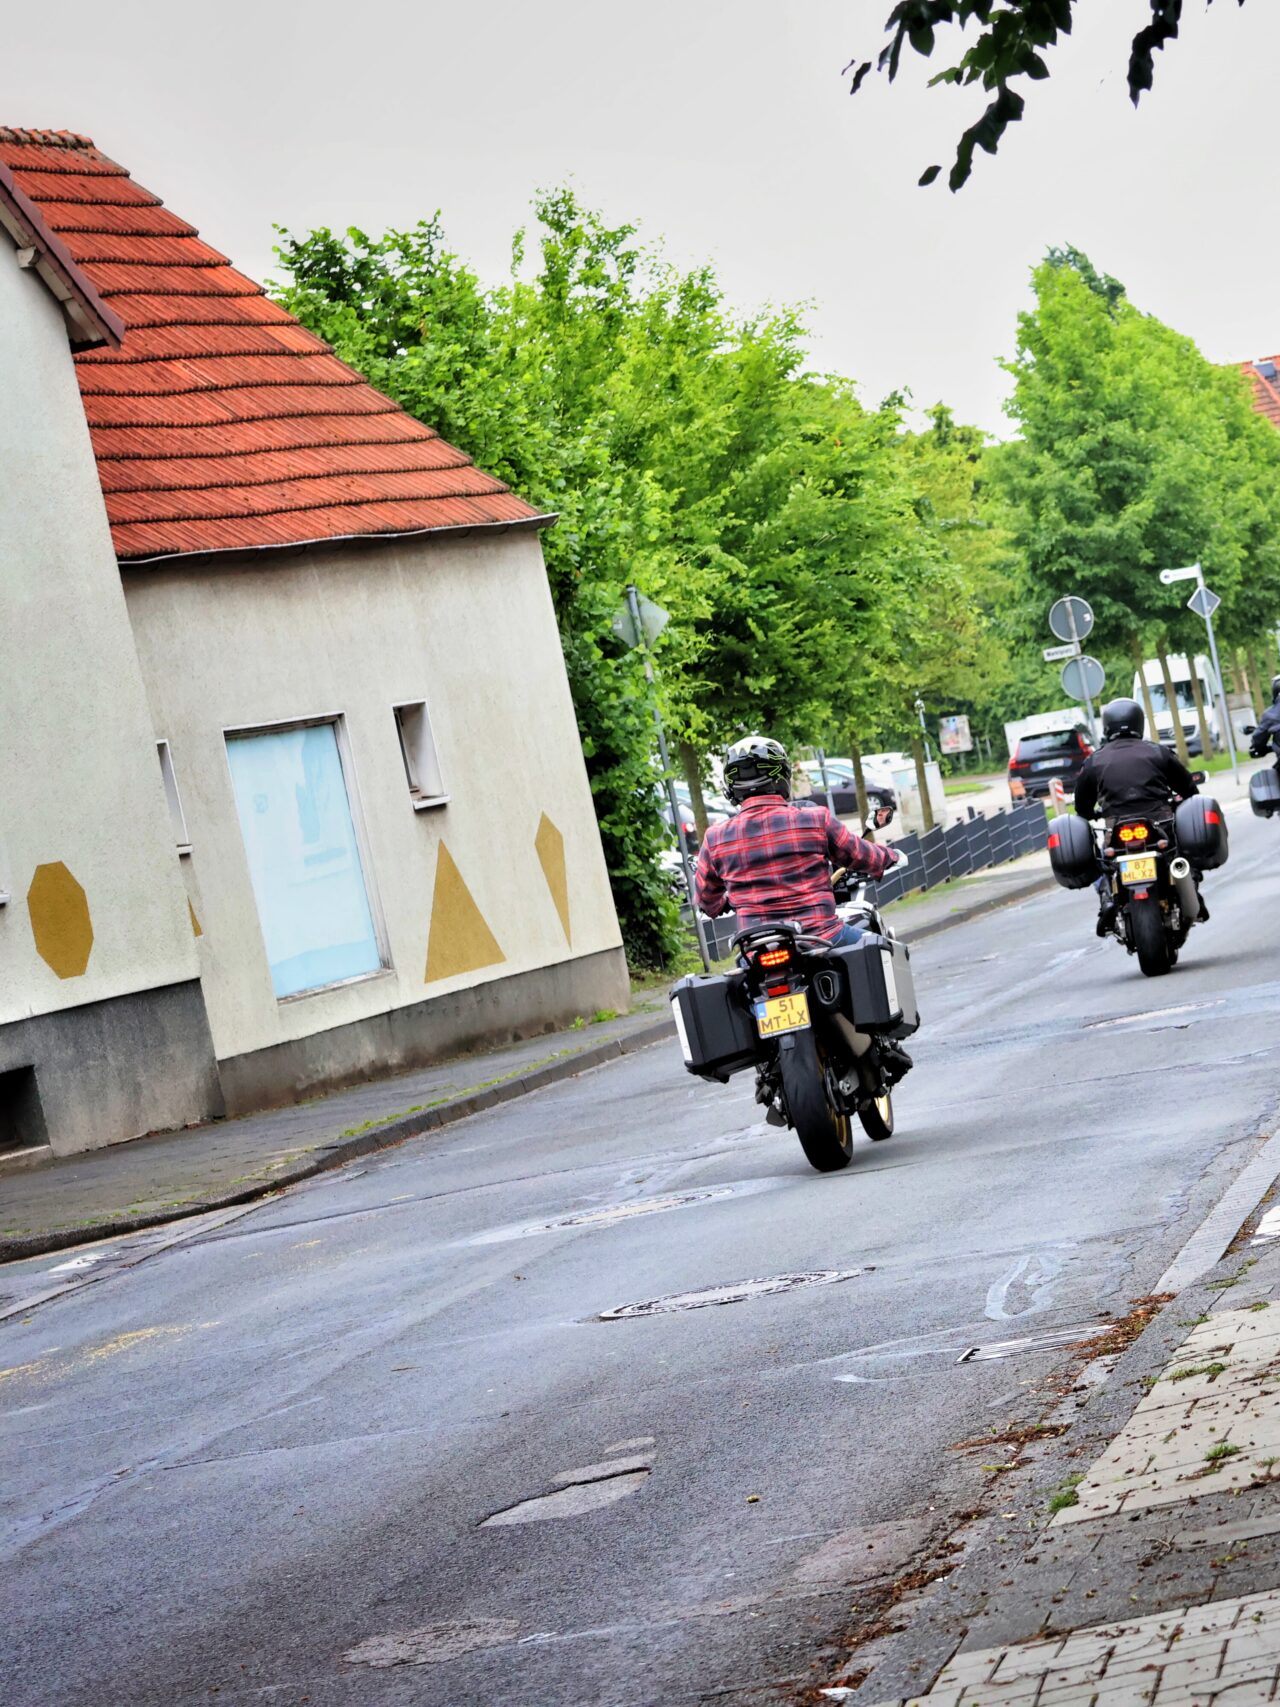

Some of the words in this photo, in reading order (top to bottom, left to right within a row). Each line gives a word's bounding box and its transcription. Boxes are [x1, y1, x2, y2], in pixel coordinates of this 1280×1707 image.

[1134, 860, 1147, 870] 87
[778, 998, 794, 1012] 51
[760, 1010, 807, 1032] MT-LX
